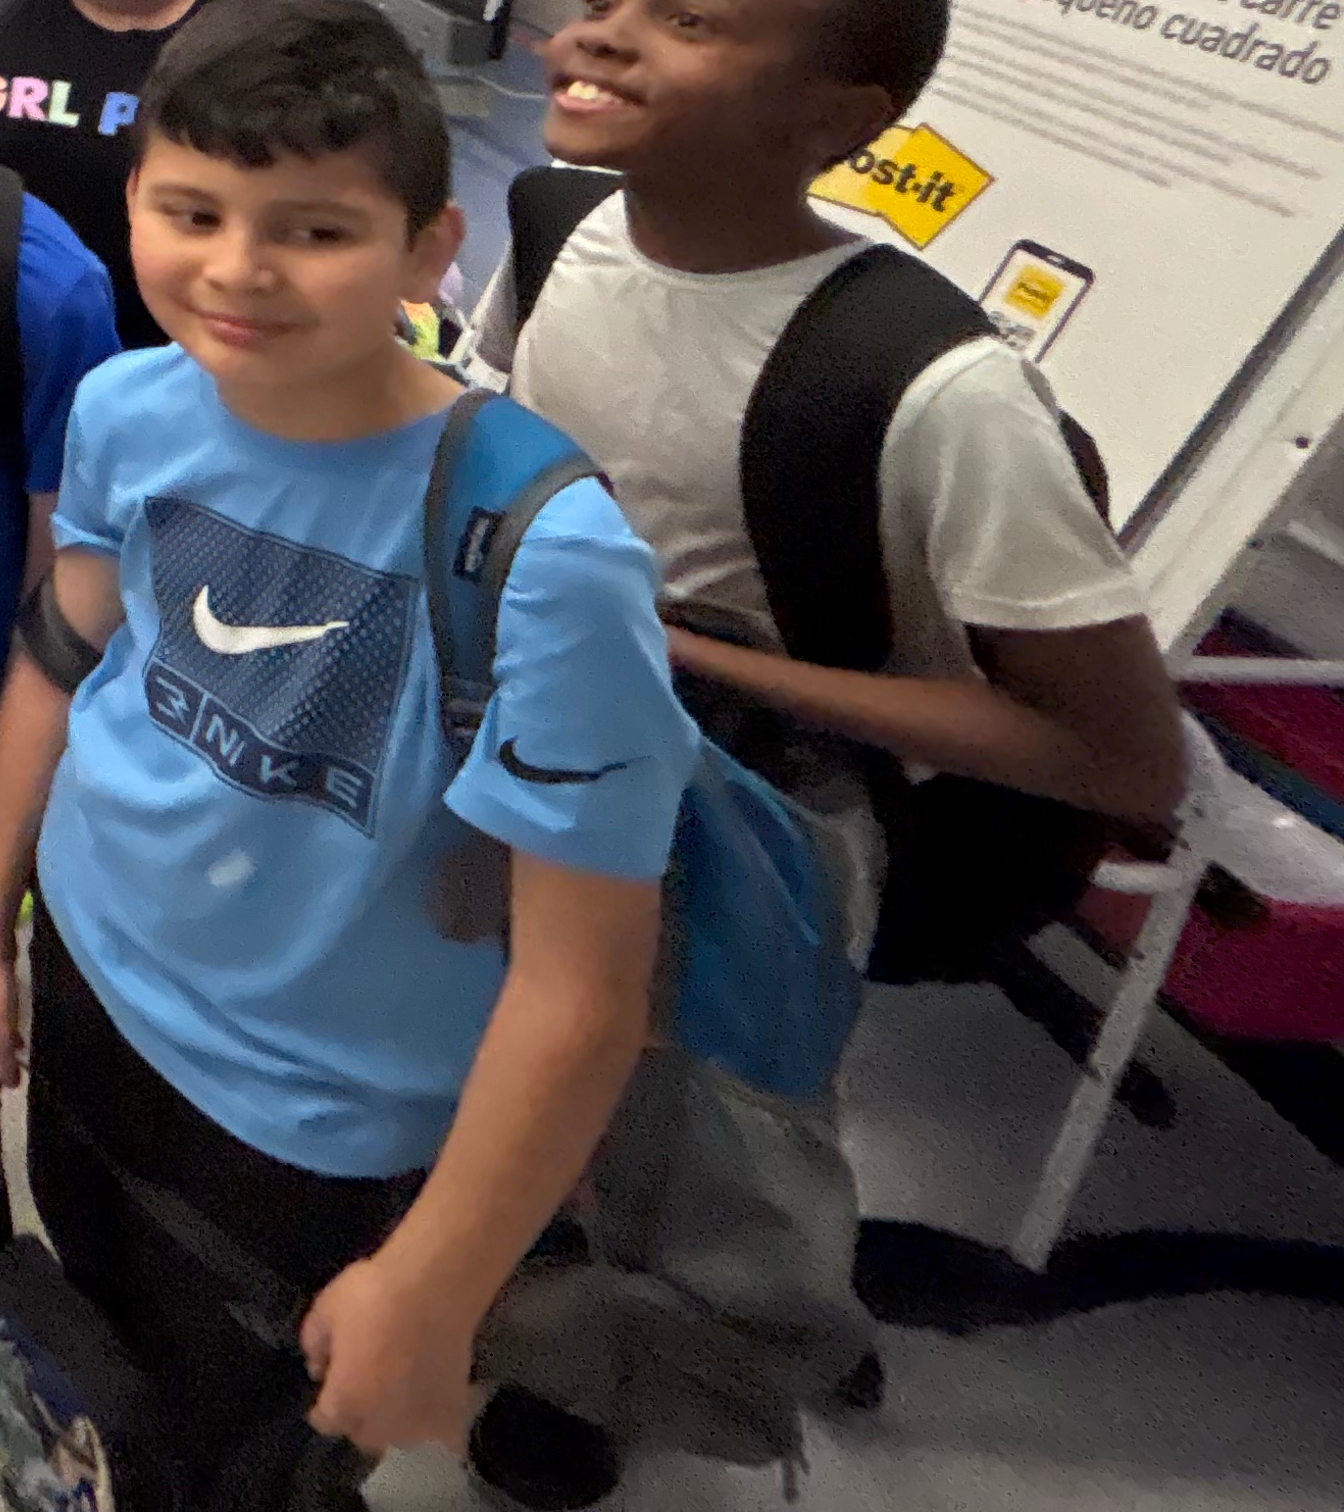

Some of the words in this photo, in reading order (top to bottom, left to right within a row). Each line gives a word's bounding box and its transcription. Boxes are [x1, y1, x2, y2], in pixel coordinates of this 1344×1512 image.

[1160, 13, 1332, 85] cuadrado
[98, 91, 140, 136] P
[849, 149, 955, 212] ost-it
[205, 712, 362, 808] NIKE
